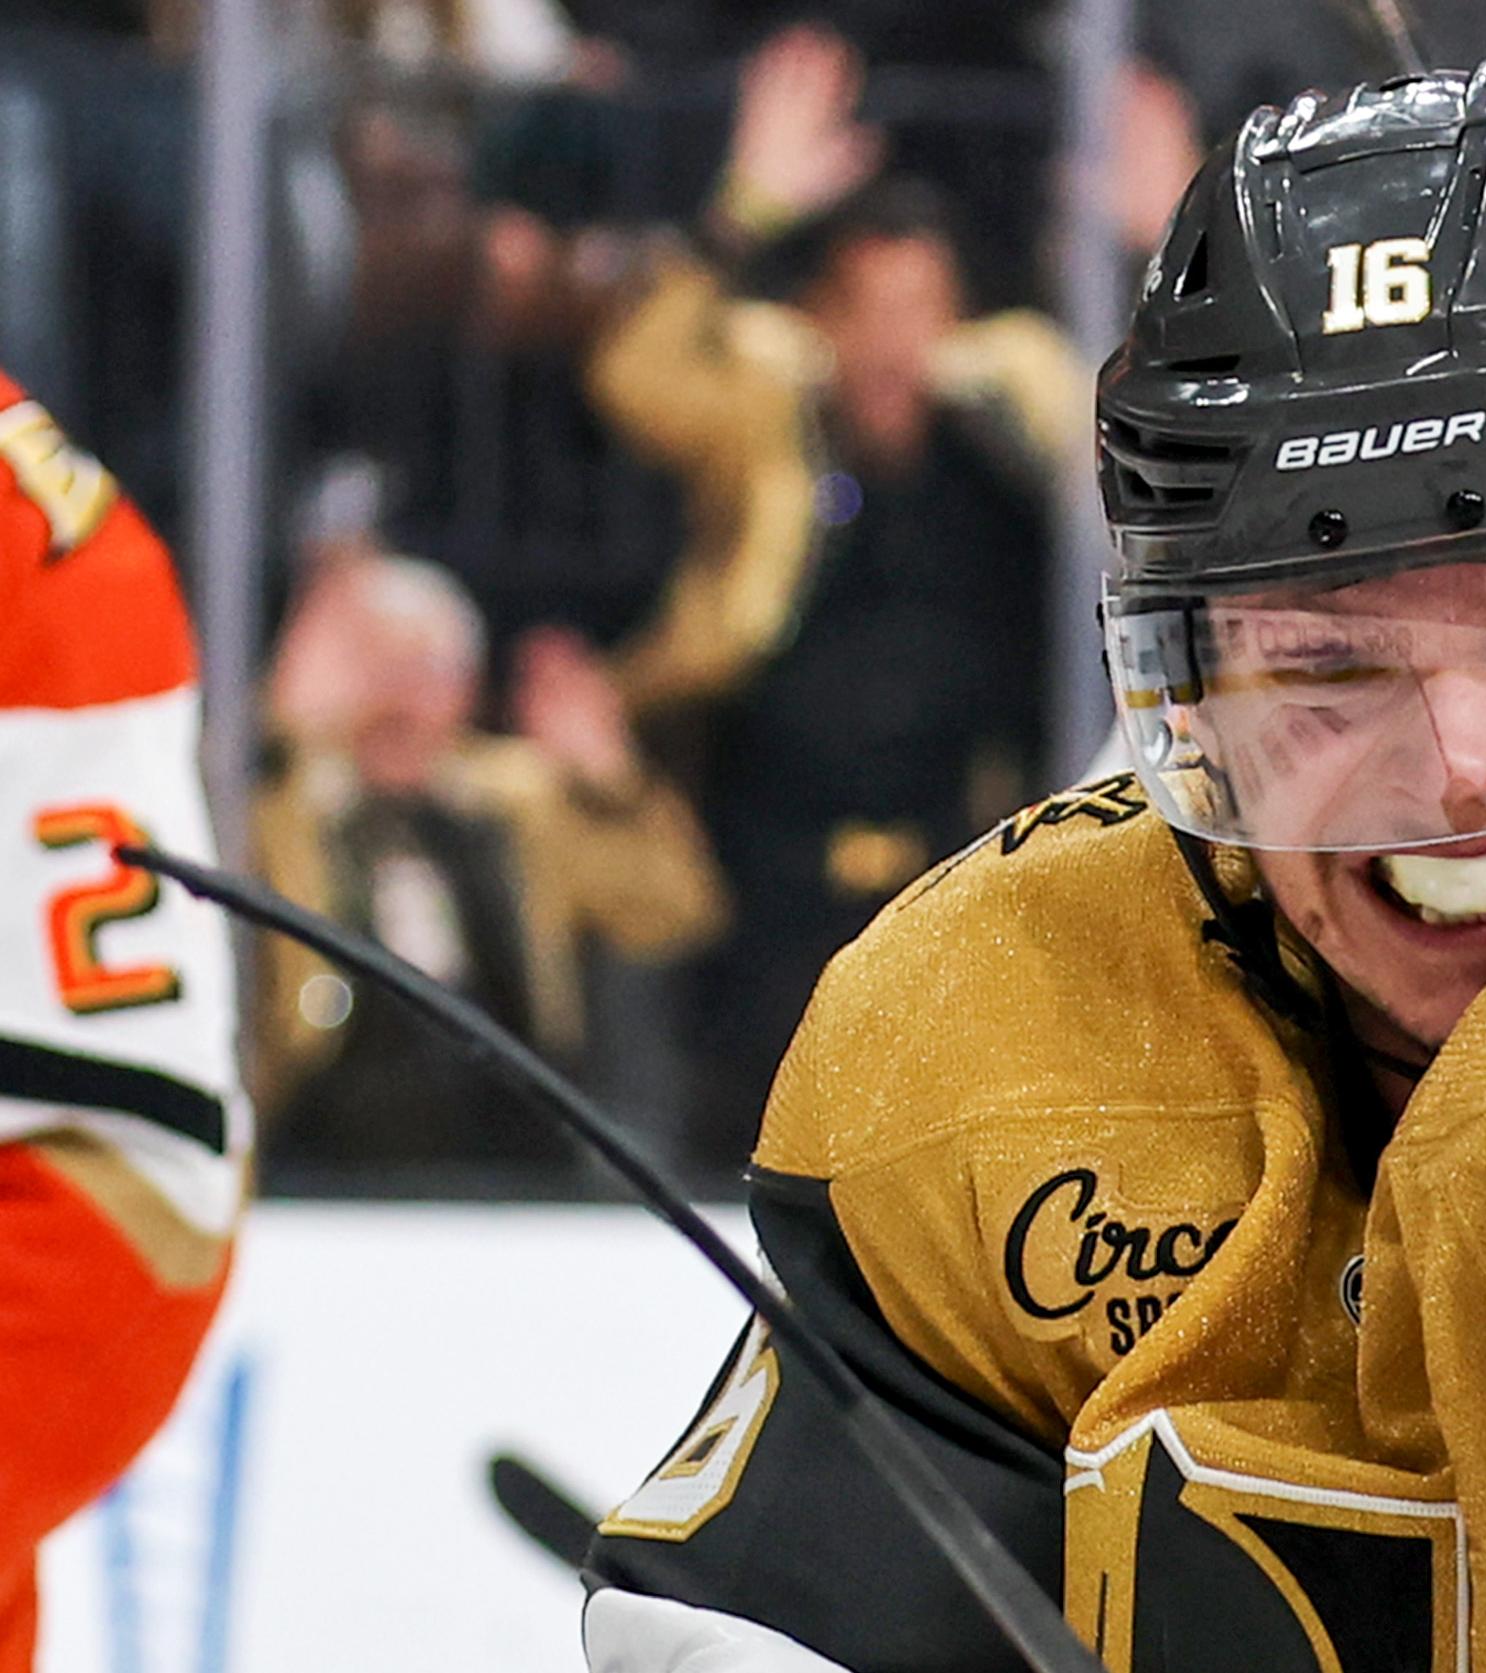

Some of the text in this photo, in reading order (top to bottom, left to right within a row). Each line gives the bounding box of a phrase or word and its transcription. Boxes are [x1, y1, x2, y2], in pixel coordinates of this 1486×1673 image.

[1322, 236, 1431, 335] 16
[1275, 411, 1486, 470] BAUER
[33, 803, 182, 1012] 2
[1106, 1292, 1183, 1357] SP
